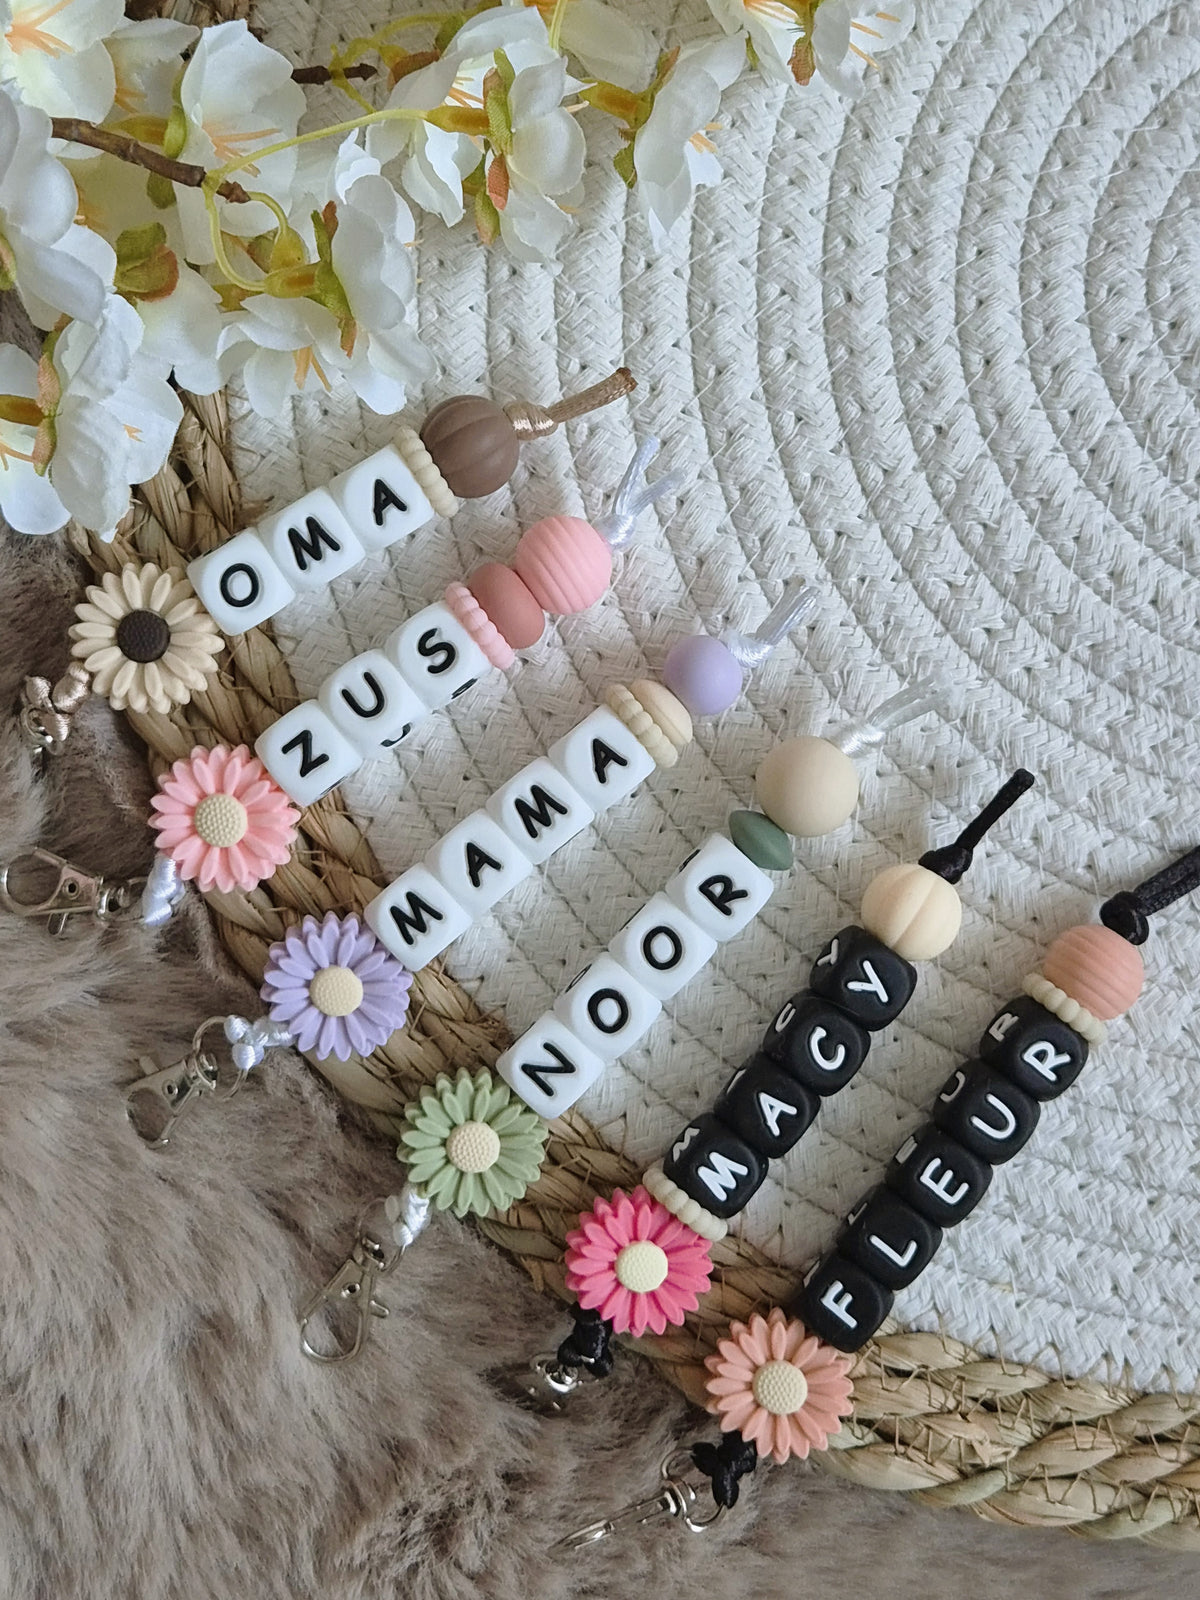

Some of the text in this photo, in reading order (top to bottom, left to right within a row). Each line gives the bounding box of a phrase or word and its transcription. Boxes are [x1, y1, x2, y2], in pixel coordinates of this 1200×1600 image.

[219, 478, 408, 608] OMA
[281, 628, 456, 778] ZUS
[389, 738, 628, 946] MAMA
[521, 874, 748, 1097] NOOR
[697, 960, 889, 1202] MACY
[820, 1040, 1071, 1329] FLEUR
